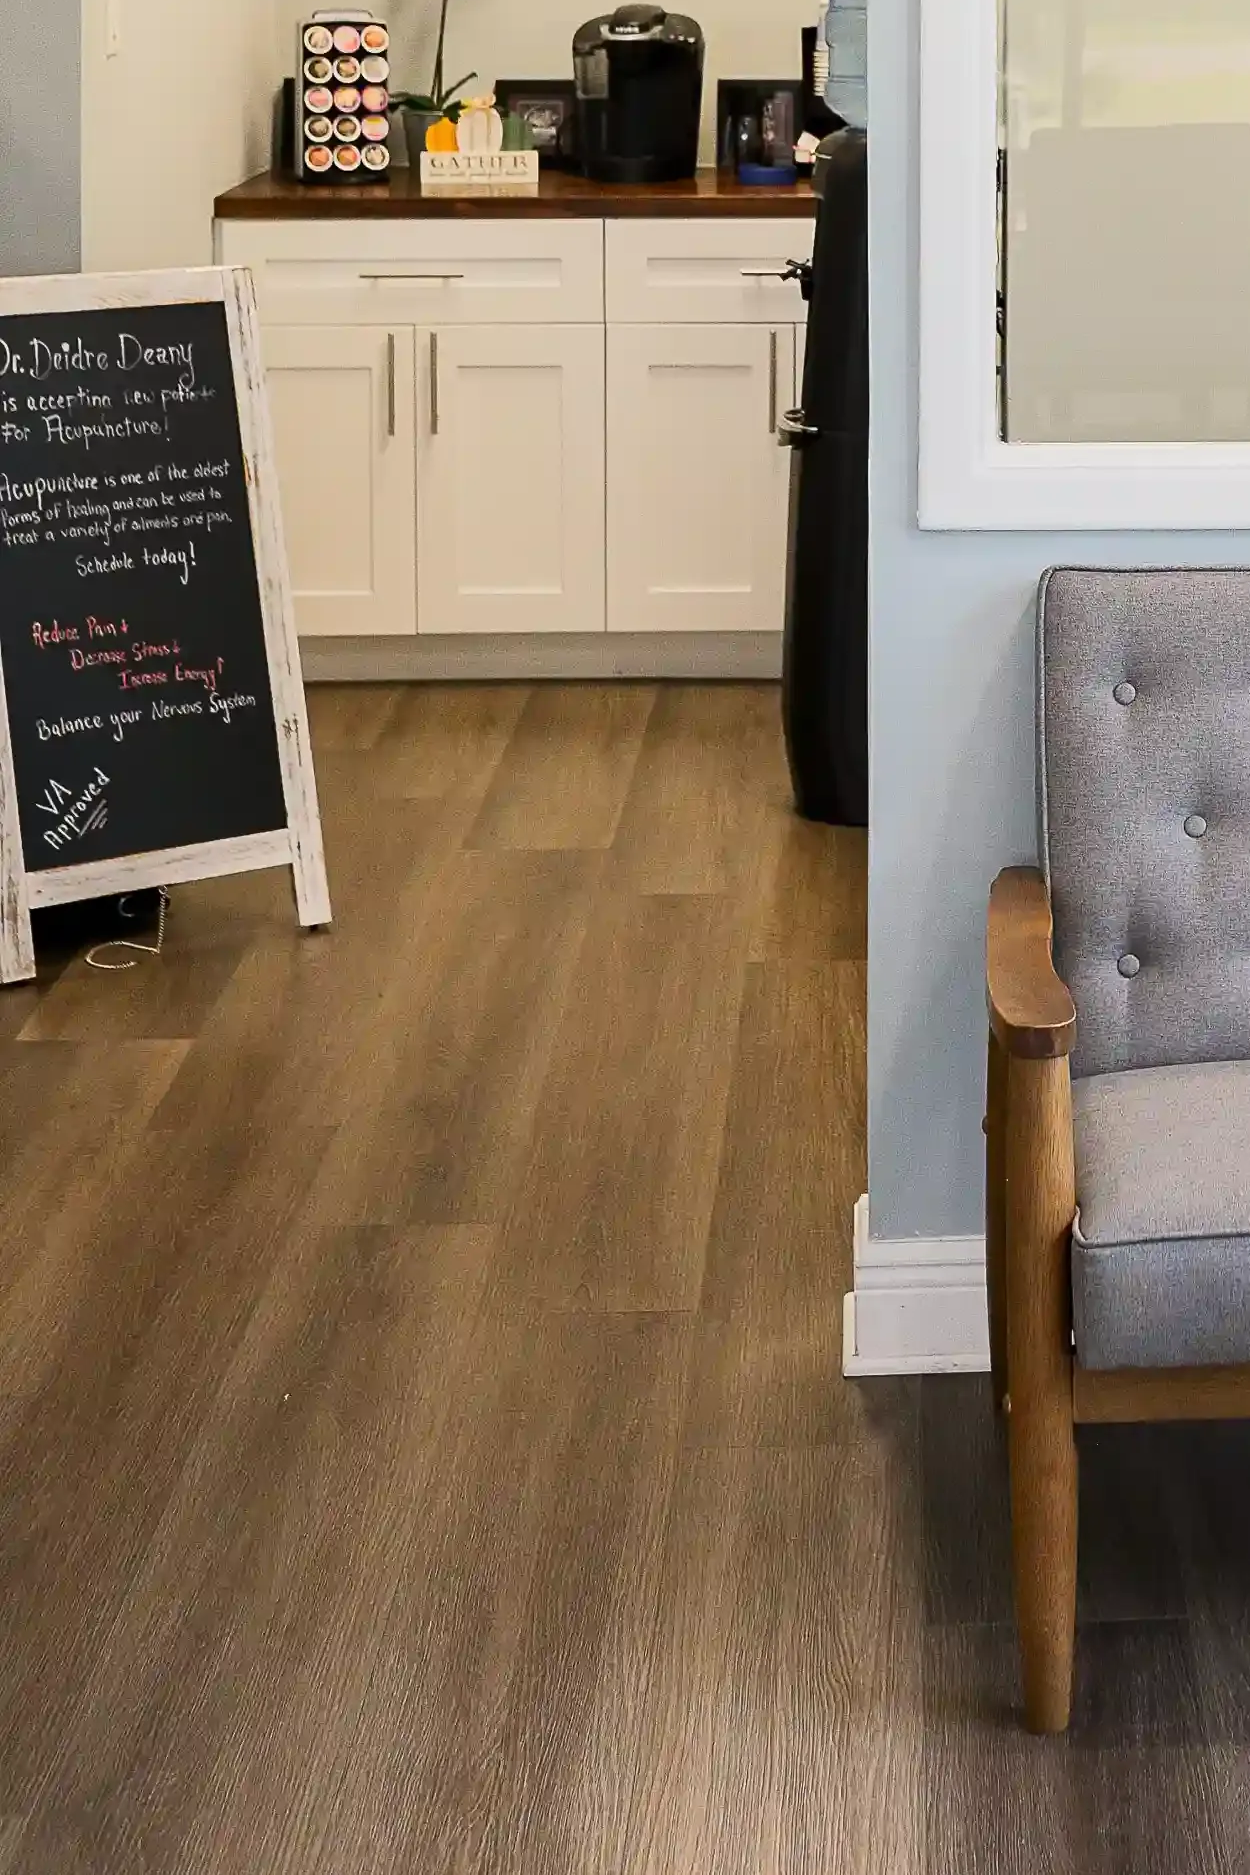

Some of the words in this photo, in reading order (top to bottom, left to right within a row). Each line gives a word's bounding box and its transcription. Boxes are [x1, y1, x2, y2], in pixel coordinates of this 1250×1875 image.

[30, 337, 109, 380] Deidre
[2, 391, 18, 413] is
[104, 471, 117, 487] is
[120, 473, 144, 485] one
[168, 462, 189, 481] the
[193, 459, 231, 477] oldest
[66, 497, 112, 527] healing
[3, 529, 40, 547] treat
[45, 529, 56, 543] a
[75, 552, 135, 578] Schedule
[141, 540, 198, 585] today!
[32, 619, 80, 649] Reduce
[35, 714, 104, 741] Balance
[110, 708, 143, 743] your
[151, 699, 203, 722] Nervous
[209, 691, 256, 725] System
[35, 778, 72, 815] VA
